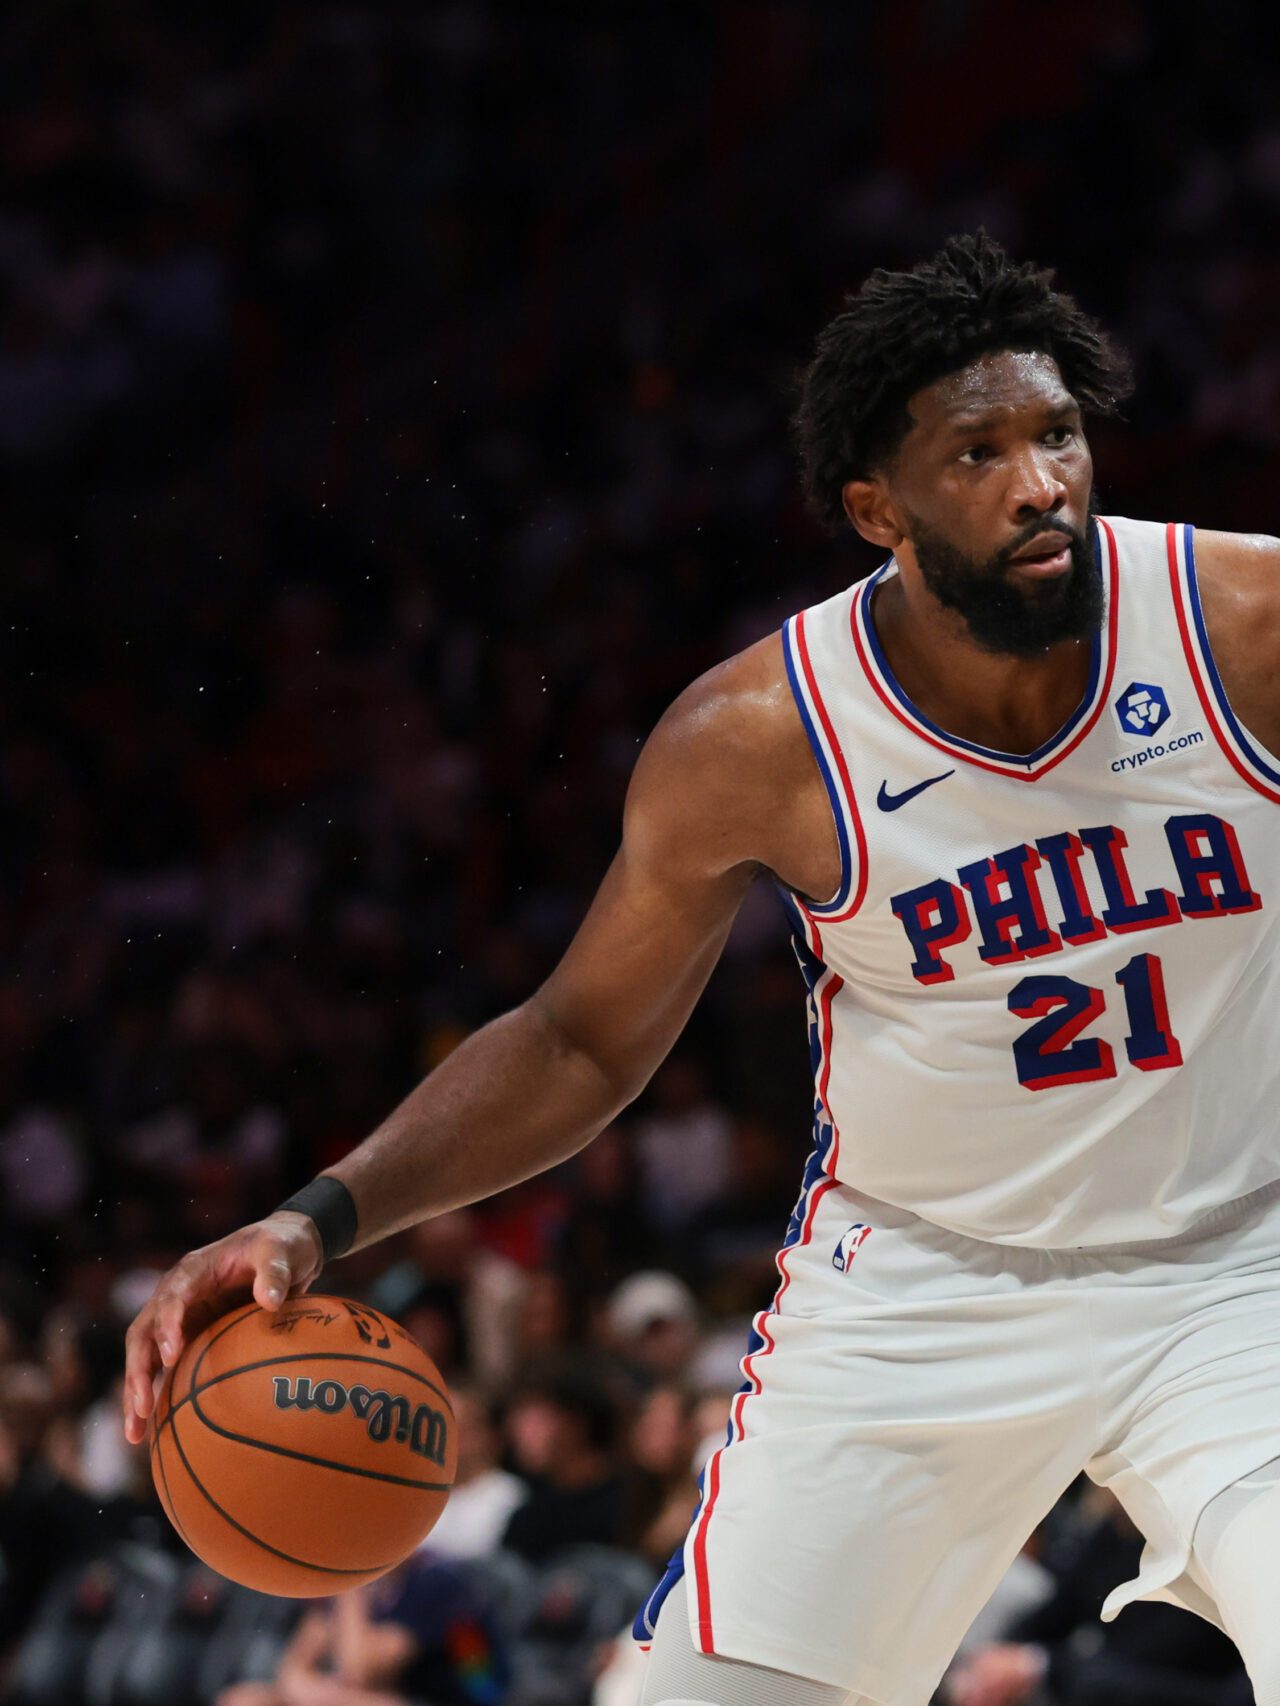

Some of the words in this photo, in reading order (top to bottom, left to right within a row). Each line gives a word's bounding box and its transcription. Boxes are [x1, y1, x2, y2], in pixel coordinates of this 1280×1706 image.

[1111, 731, 1204, 773] crypto.com
[890, 813, 1263, 986] PHILA
[1007, 952, 1184, 1092] 21
[272, 1376, 448, 1467] Wilson
